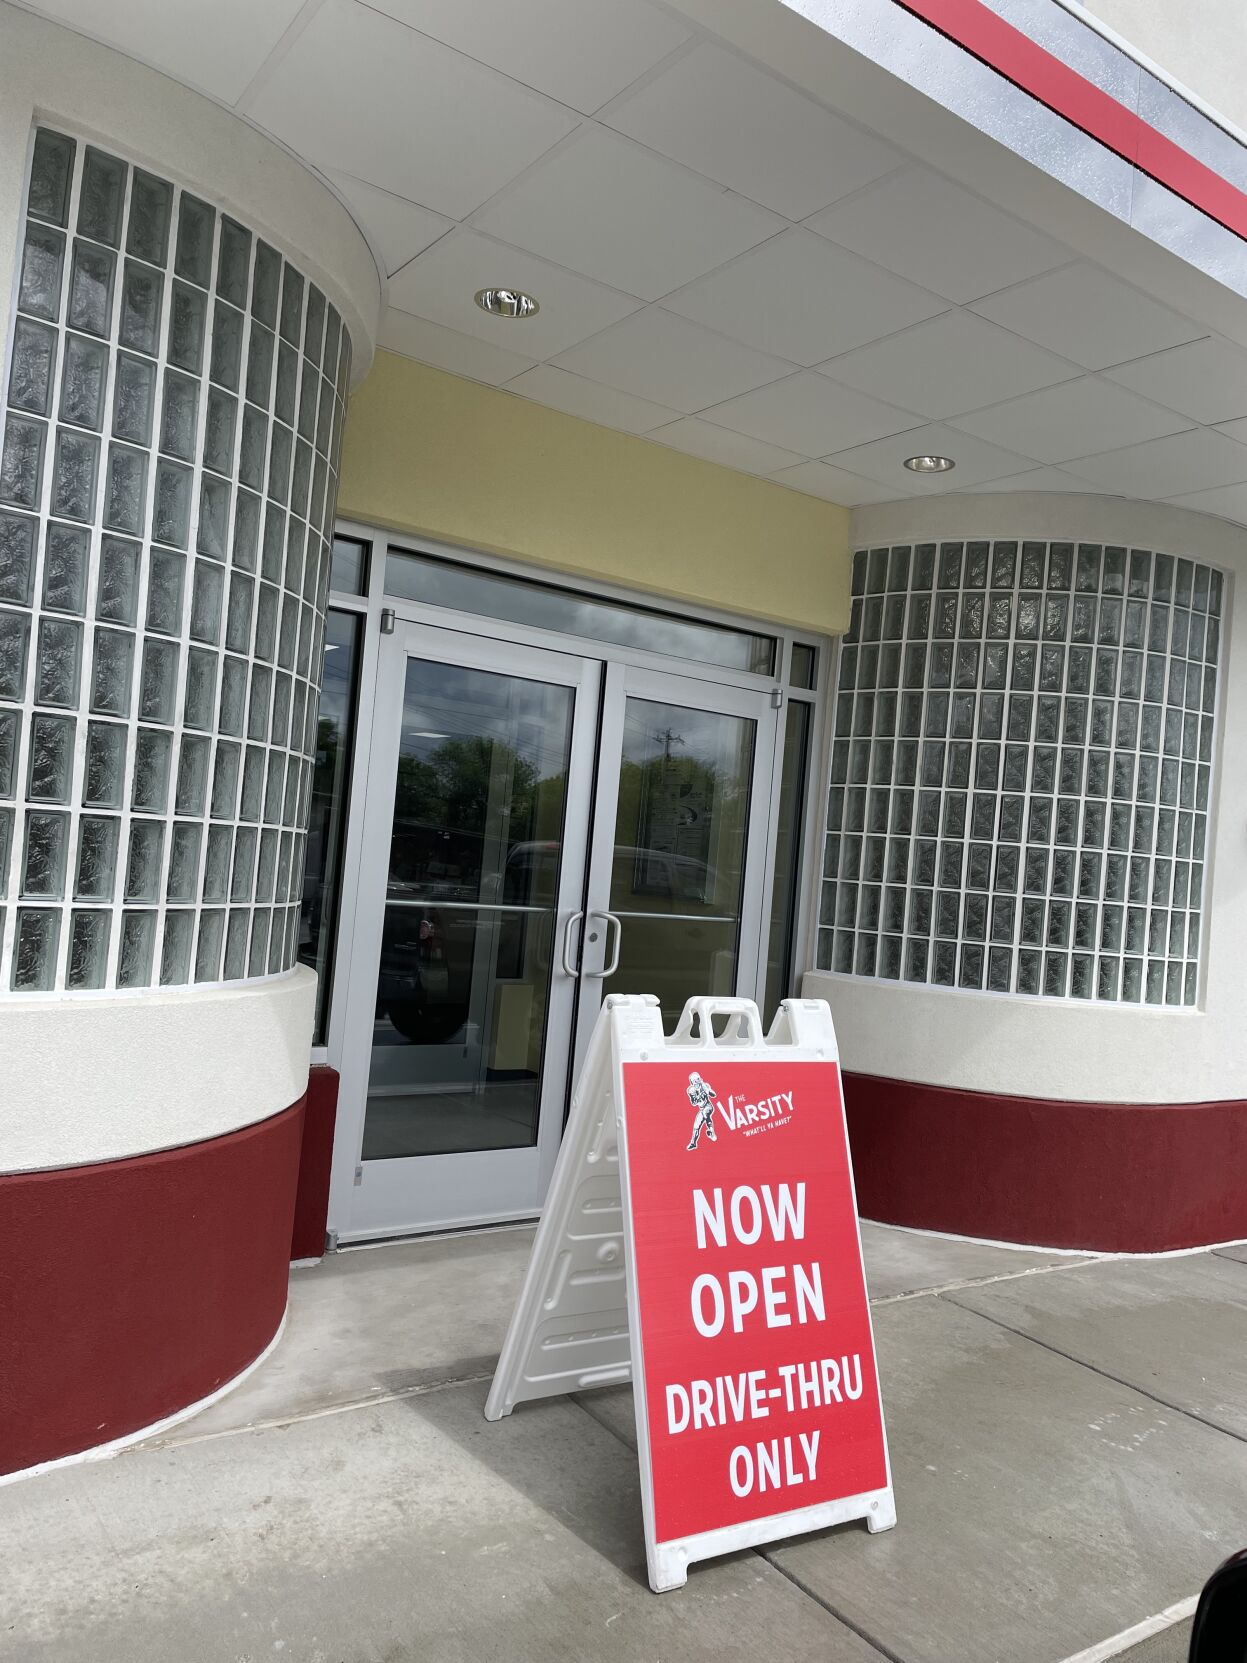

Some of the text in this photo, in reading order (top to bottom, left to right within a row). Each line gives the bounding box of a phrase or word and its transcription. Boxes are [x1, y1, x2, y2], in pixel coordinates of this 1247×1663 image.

[716, 1091, 794, 1131] VARSITY
[735, 1094, 746, 1103] THE
[767, 1121, 774, 1129] YA
[693, 1182, 806, 1250] NOW
[690, 1262, 826, 1338] OPEN
[665, 1353, 863, 1435] DRIVE-THRU
[729, 1430, 821, 1498] ONLY
